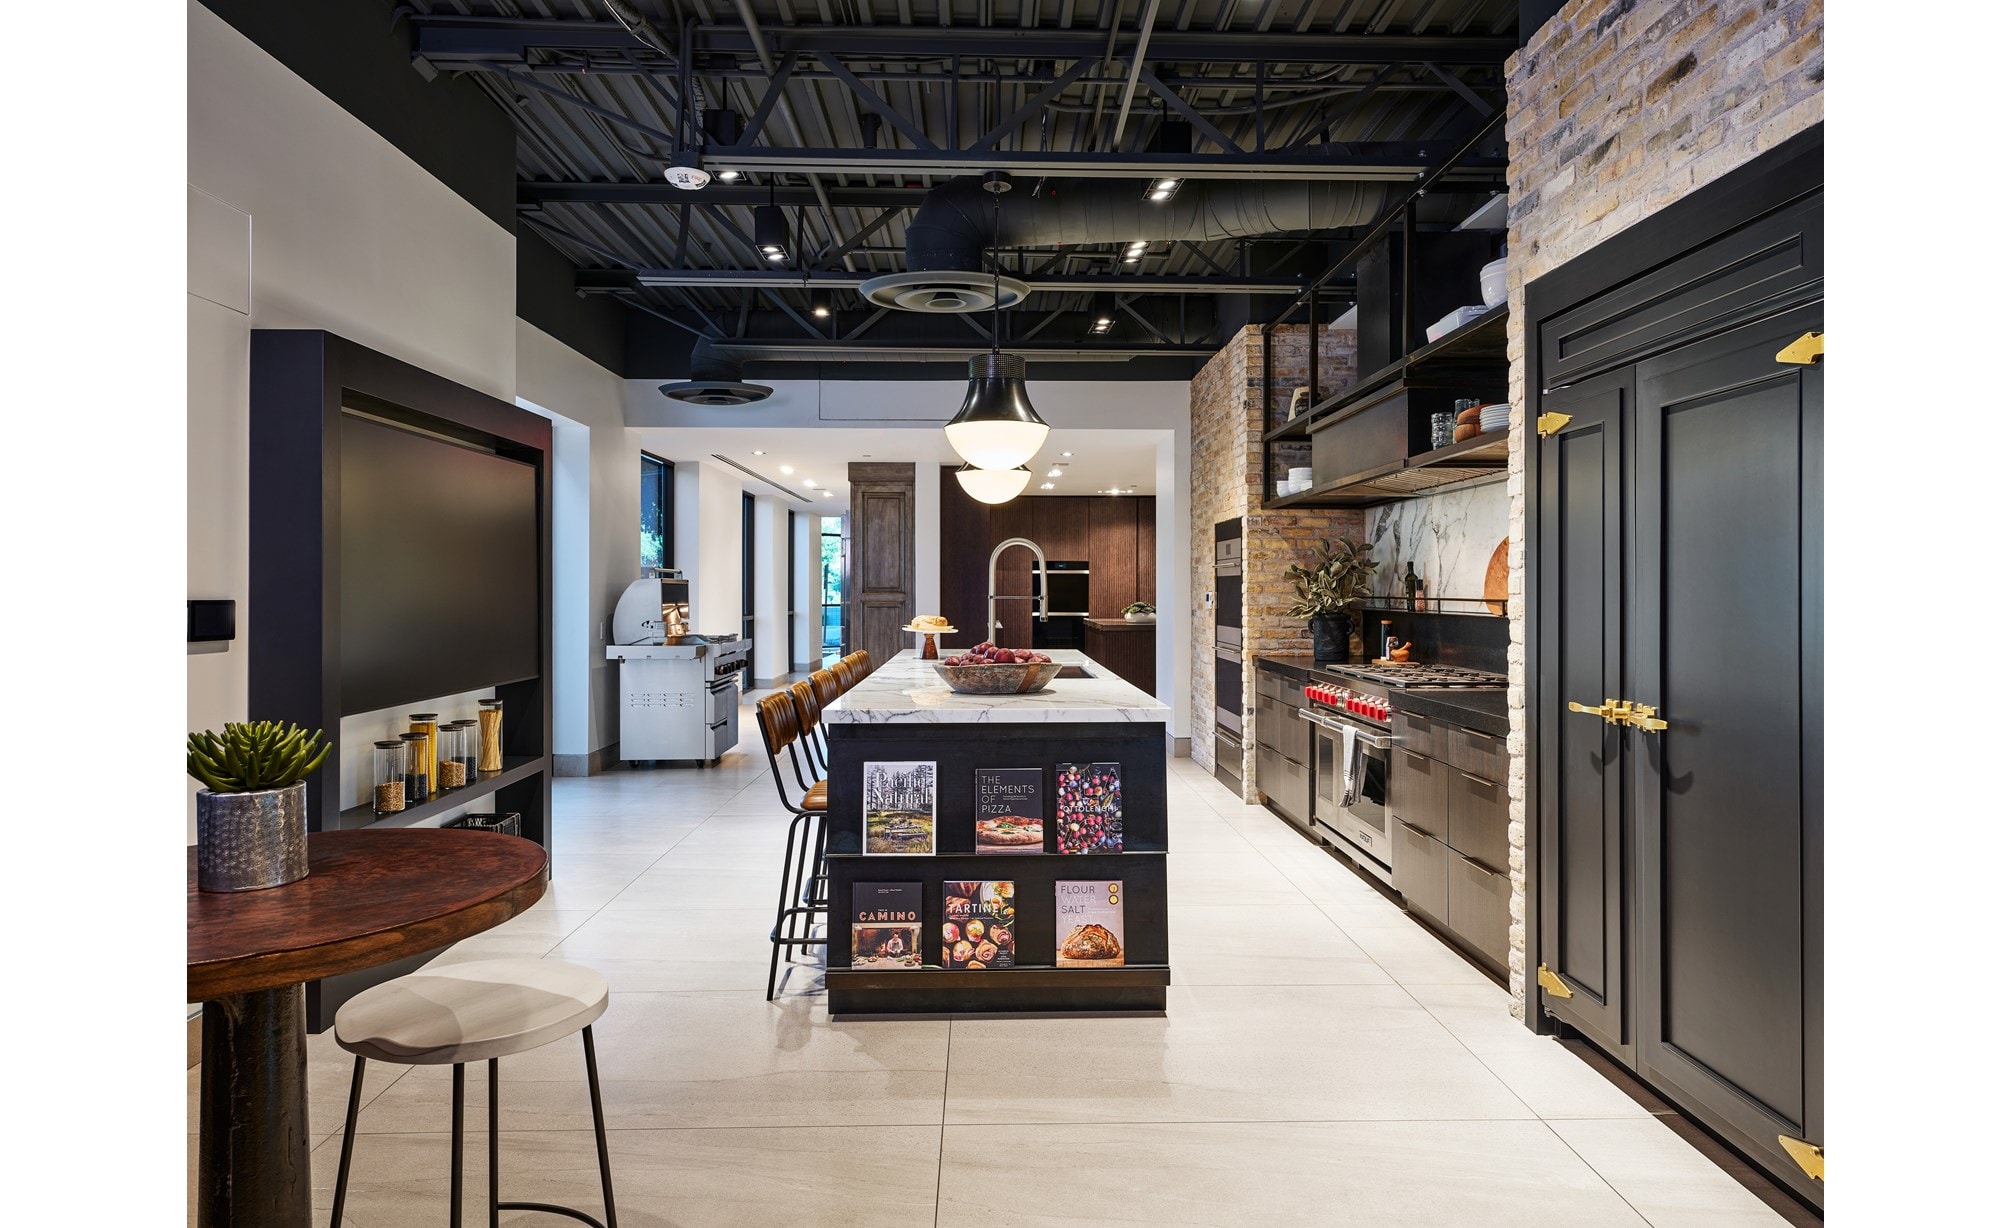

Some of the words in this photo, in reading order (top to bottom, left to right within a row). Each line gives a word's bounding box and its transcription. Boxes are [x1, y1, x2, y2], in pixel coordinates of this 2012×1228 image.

[876, 772, 922, 788] Pacific
[981, 775, 1001, 785] THE
[981, 784, 1035, 794] ELEMENTS
[873, 787, 929, 804] Natural
[981, 794, 996, 804] OF
[981, 804, 1012, 814] PIZZA
[1062, 805, 1119, 813] OTTOLENGHI
[1060, 885, 1095, 894] FLOUR
[1061, 895, 1096, 904] WATER
[948, 903, 999, 913] TARTINE
[1061, 904, 1086, 914] SALT
[859, 911, 916, 921] CAMINO
[1061, 915, 1093, 924] YEAST
